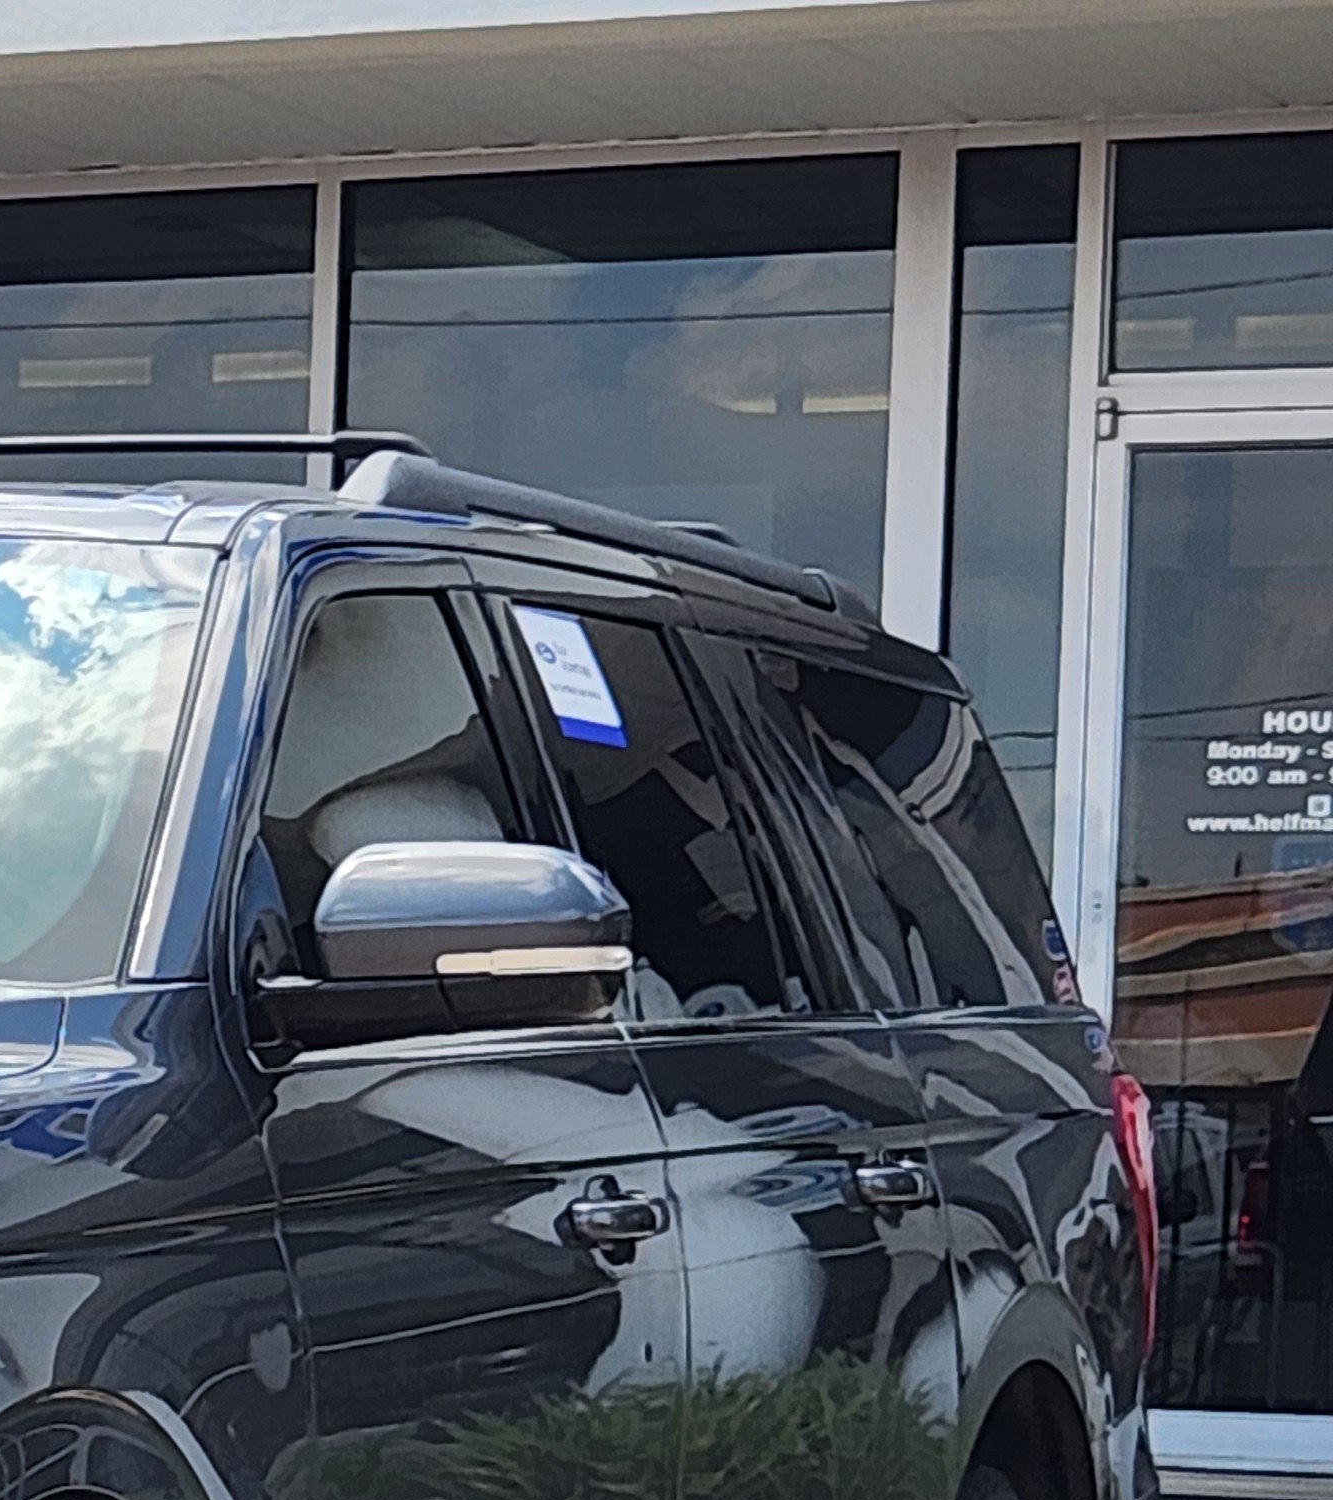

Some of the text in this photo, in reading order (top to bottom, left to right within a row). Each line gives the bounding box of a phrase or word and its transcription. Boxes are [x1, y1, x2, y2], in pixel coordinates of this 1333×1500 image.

[1207, 741, 1301, 764] Monday
[1207, 766, 1259, 786] 9:00
[1267, 769, 1308, 785] am
